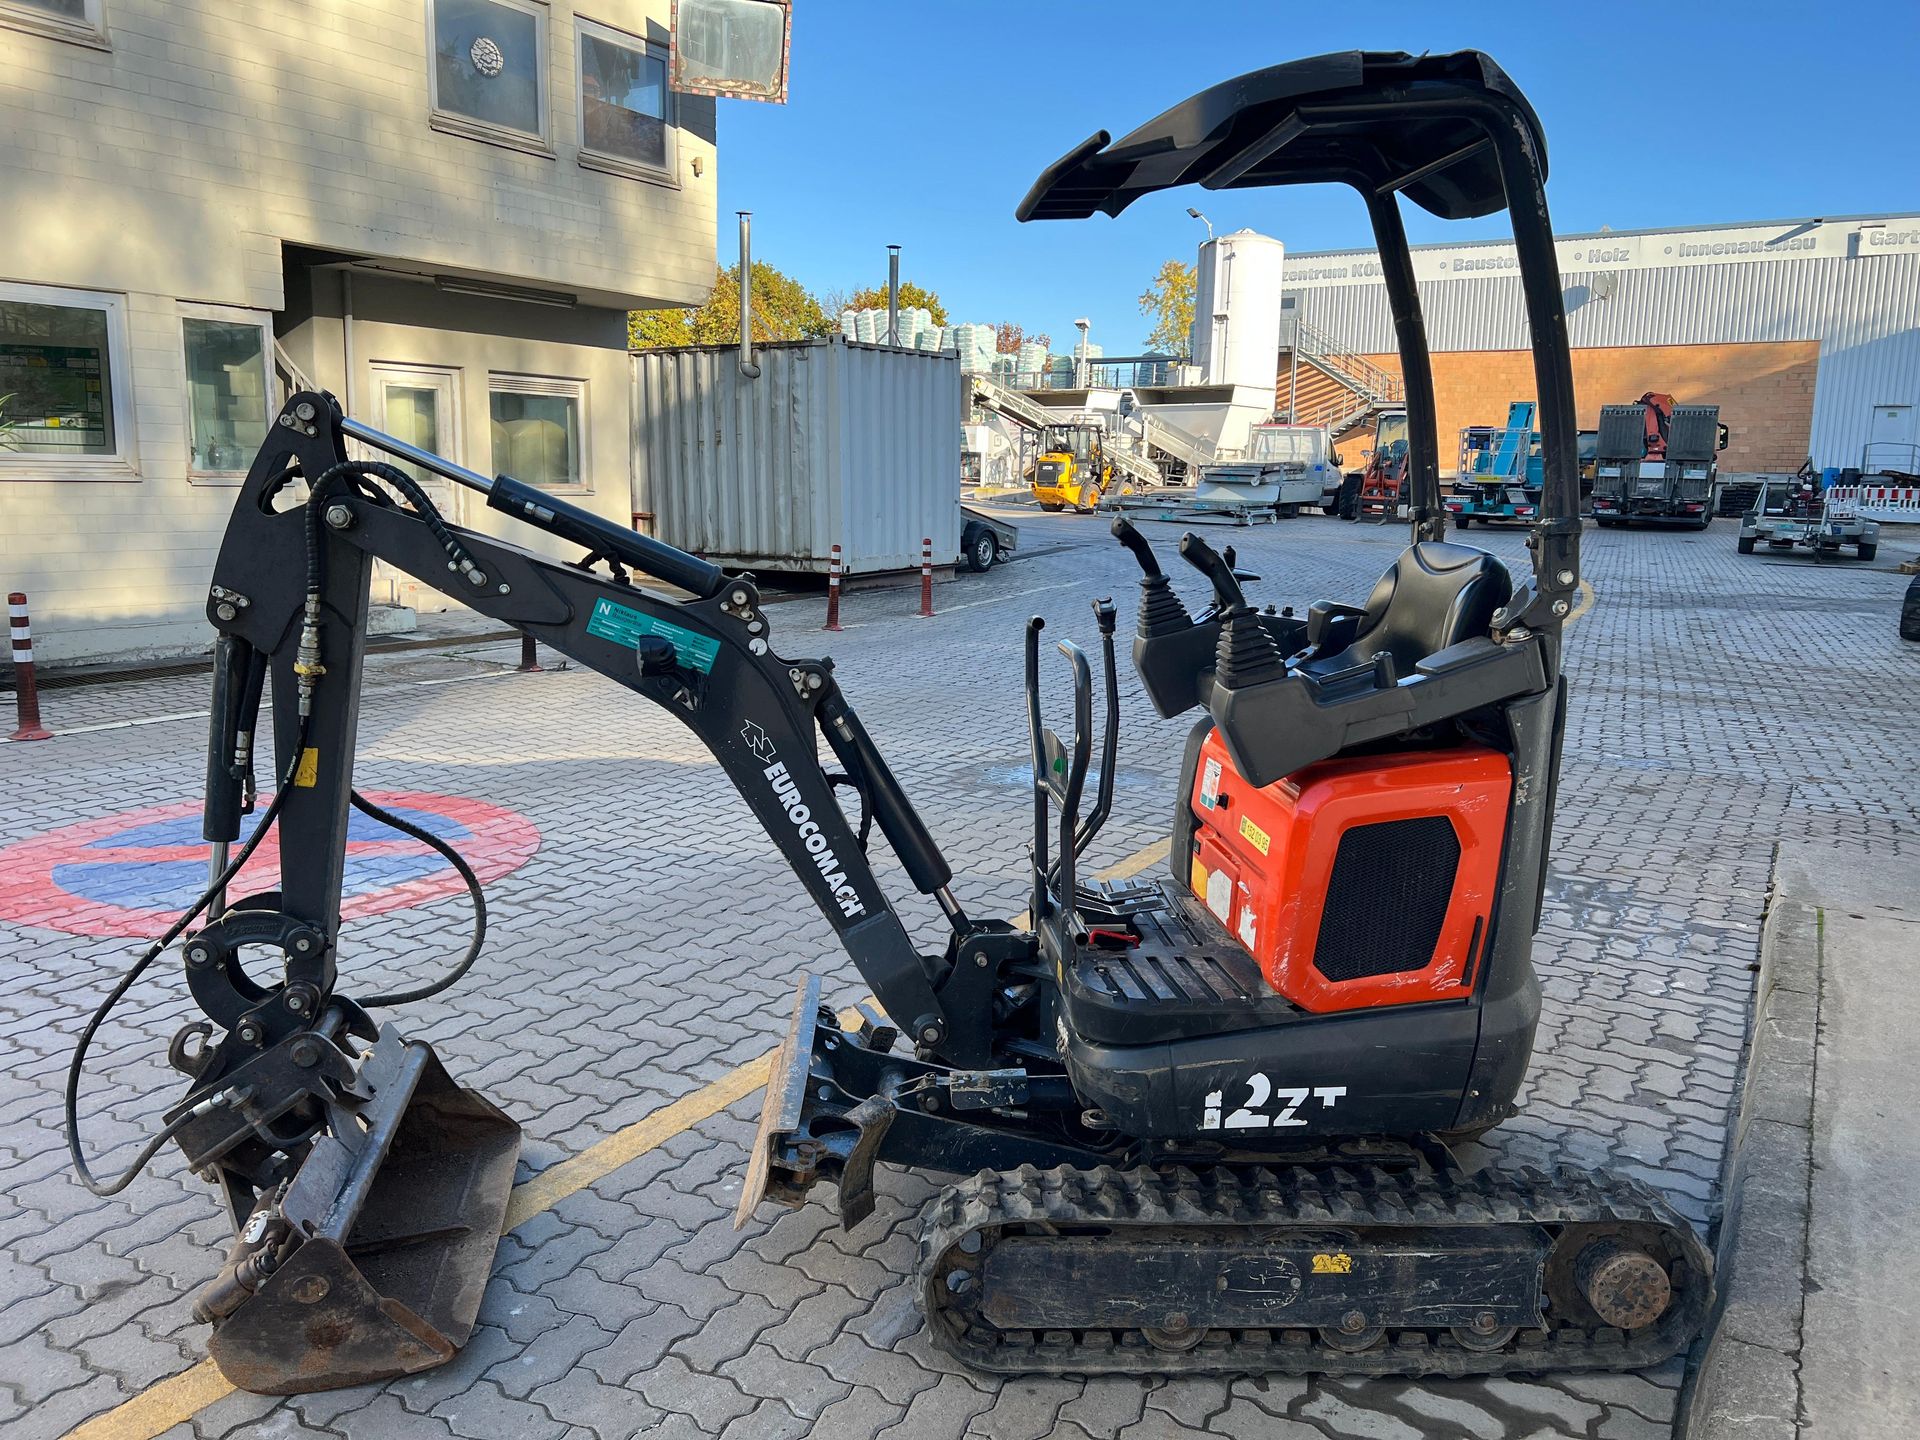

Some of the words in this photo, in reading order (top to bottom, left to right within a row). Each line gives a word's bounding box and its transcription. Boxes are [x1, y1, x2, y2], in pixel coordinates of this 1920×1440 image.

[1588, 247, 1630, 264] Holz
[598, 602, 612, 616] N
[763, 761, 865, 918] EUROCOMACH
